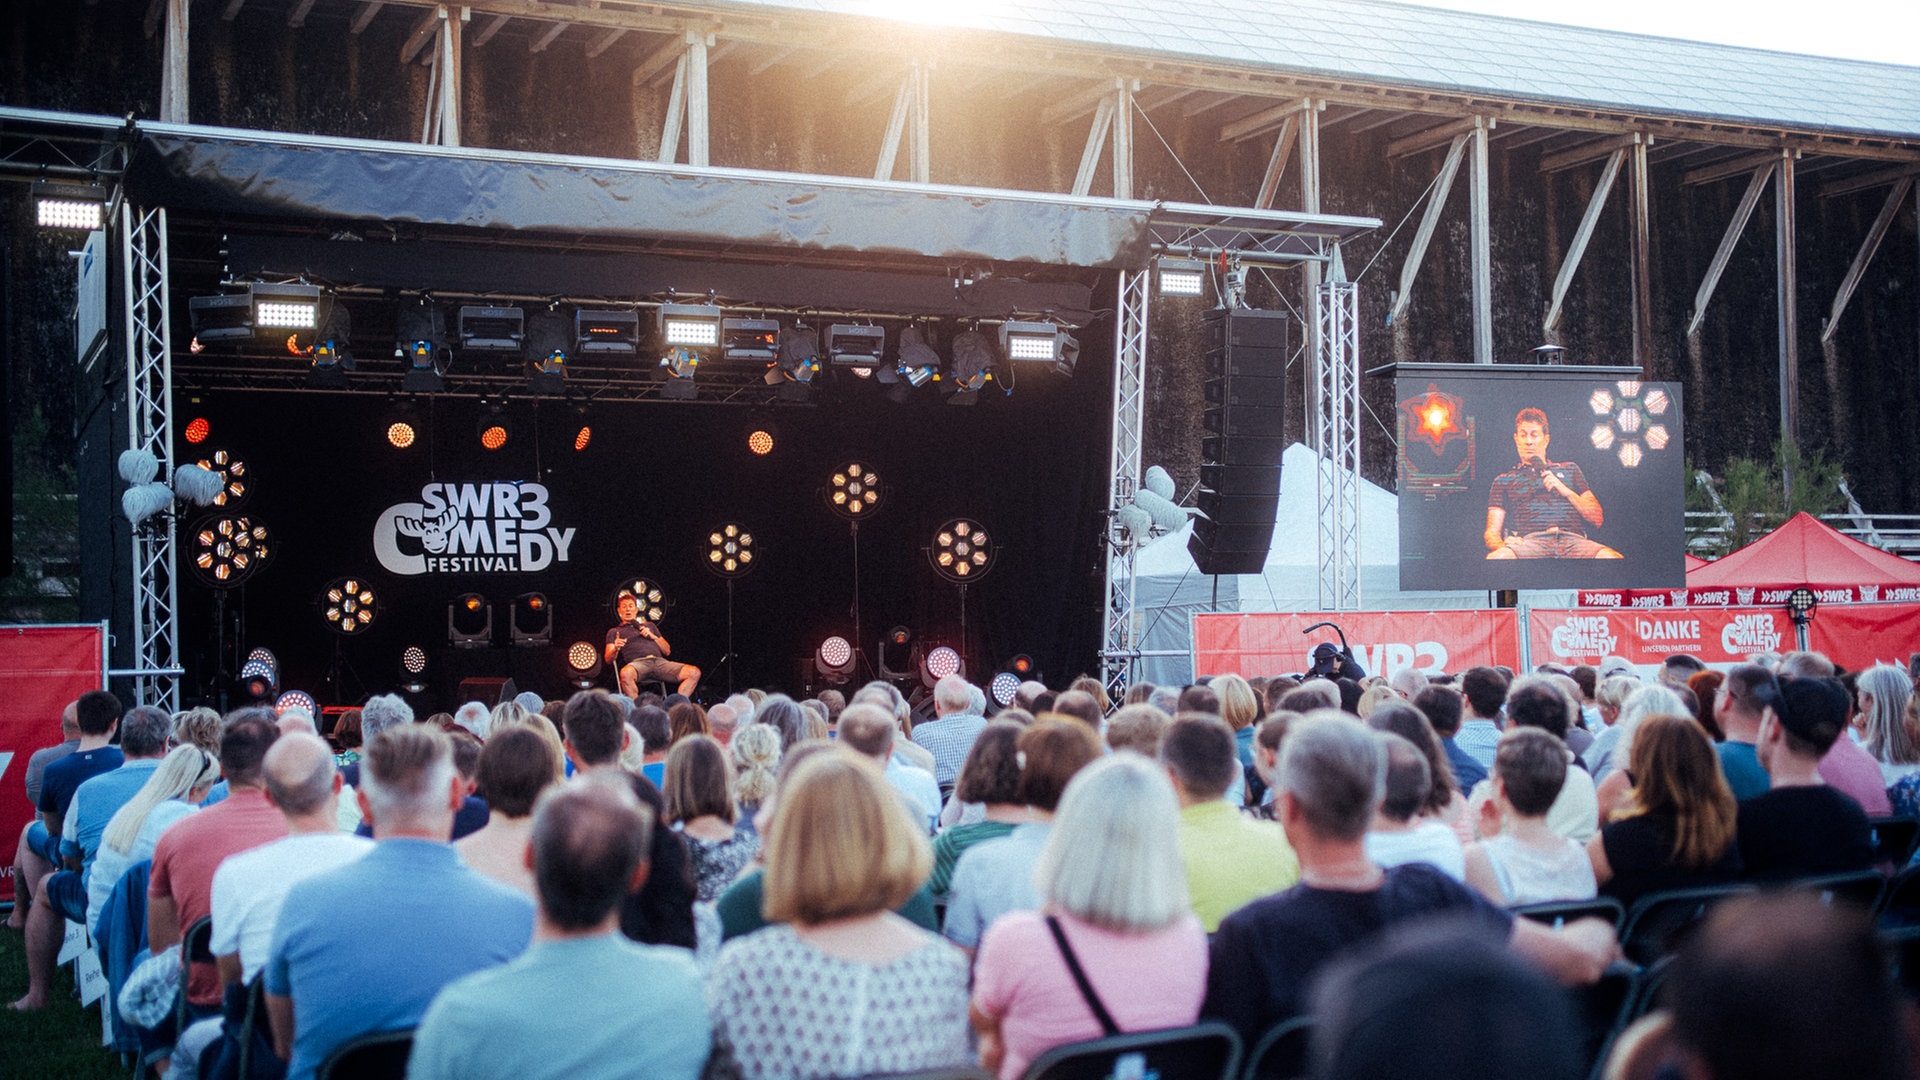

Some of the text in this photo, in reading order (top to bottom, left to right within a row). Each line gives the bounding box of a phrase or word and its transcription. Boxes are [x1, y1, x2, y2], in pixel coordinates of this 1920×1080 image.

[421, 483, 551, 530] SWR3
[428, 557, 518, 572] FESTIVAL
[1594, 592, 1621, 607] SWR3
[1639, 594, 1664, 607] SWR3
[1703, 591, 1729, 606] SWR3
[1823, 589, 1853, 603] SWR3
[1566, 616, 1609, 638] SWR3
[1640, 620, 1701, 640] DANKE
[1735, 614, 1774, 635] SWR3
[1642, 645, 1670, 653] UNSEREN
